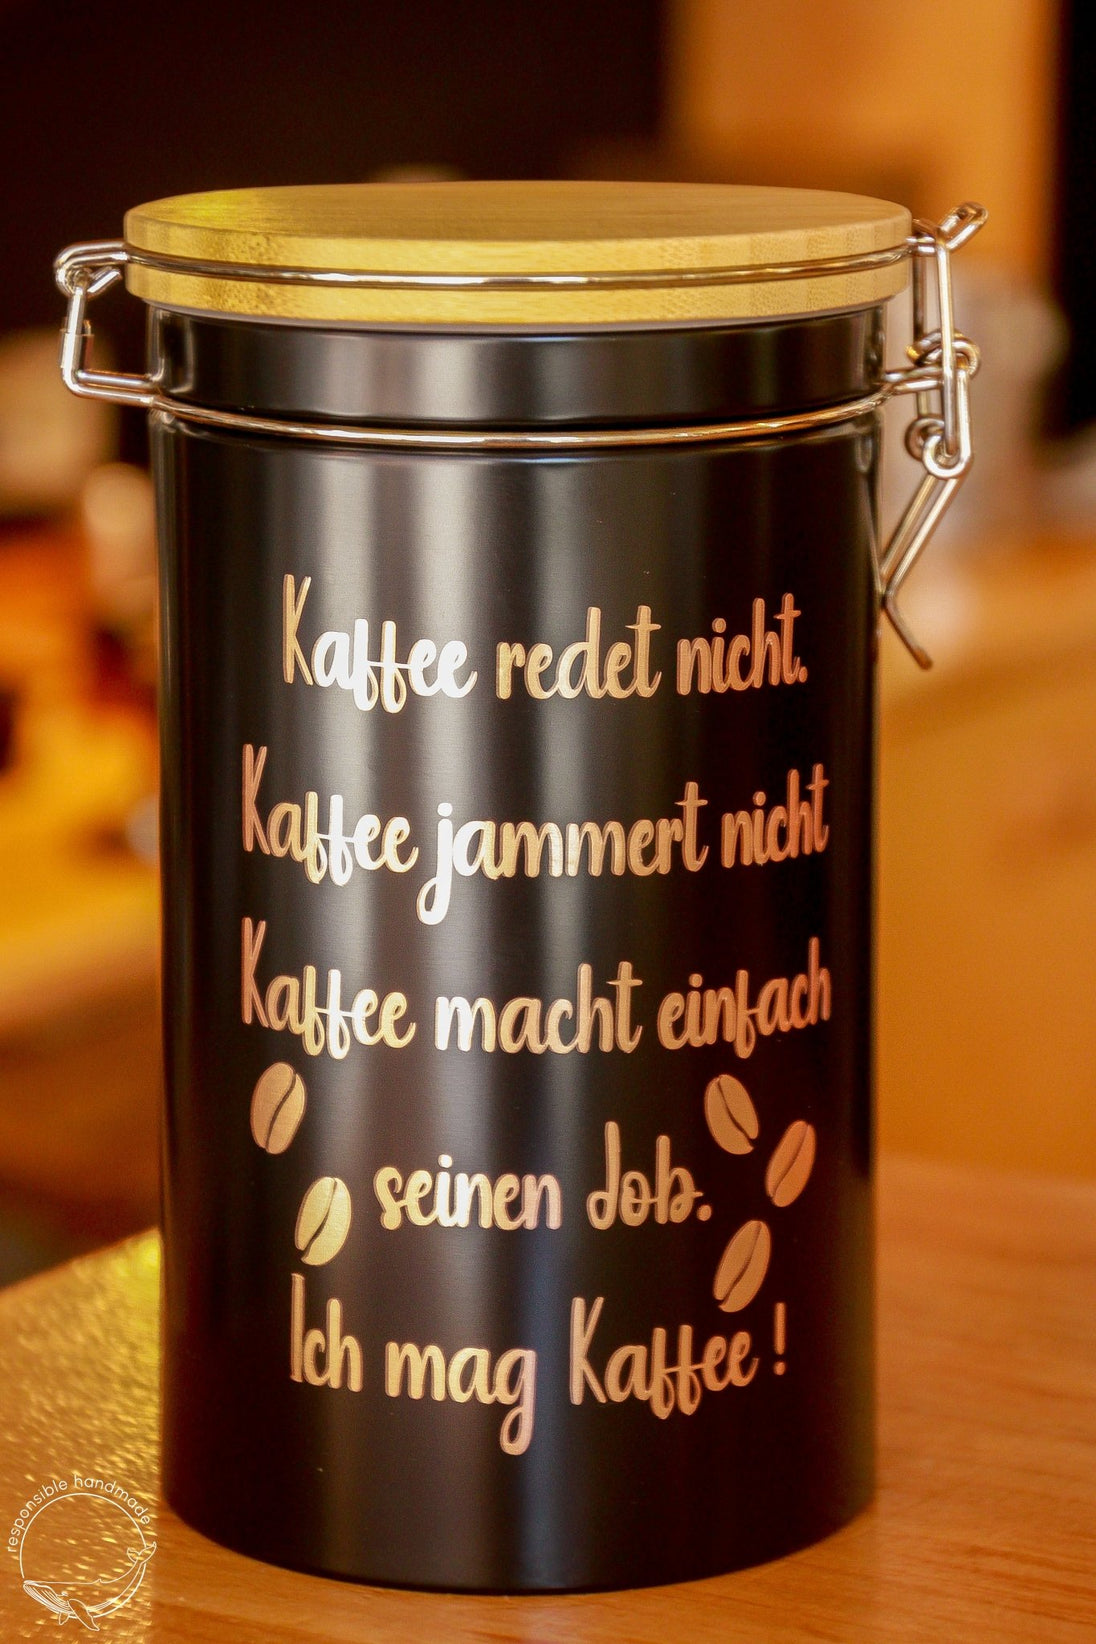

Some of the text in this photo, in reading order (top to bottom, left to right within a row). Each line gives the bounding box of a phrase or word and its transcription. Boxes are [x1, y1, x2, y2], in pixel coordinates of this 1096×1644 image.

[282, 573, 808, 714] Kaffee redet nicht.
[241, 743, 830, 925] Kaffee jammert nicht
[241, 917, 832, 1060] Kaffee macht einfach
[373, 1154, 562, 1231] seinen
[289, 1272, 364, 1393] Ich
[384, 1341, 538, 1456] mag
